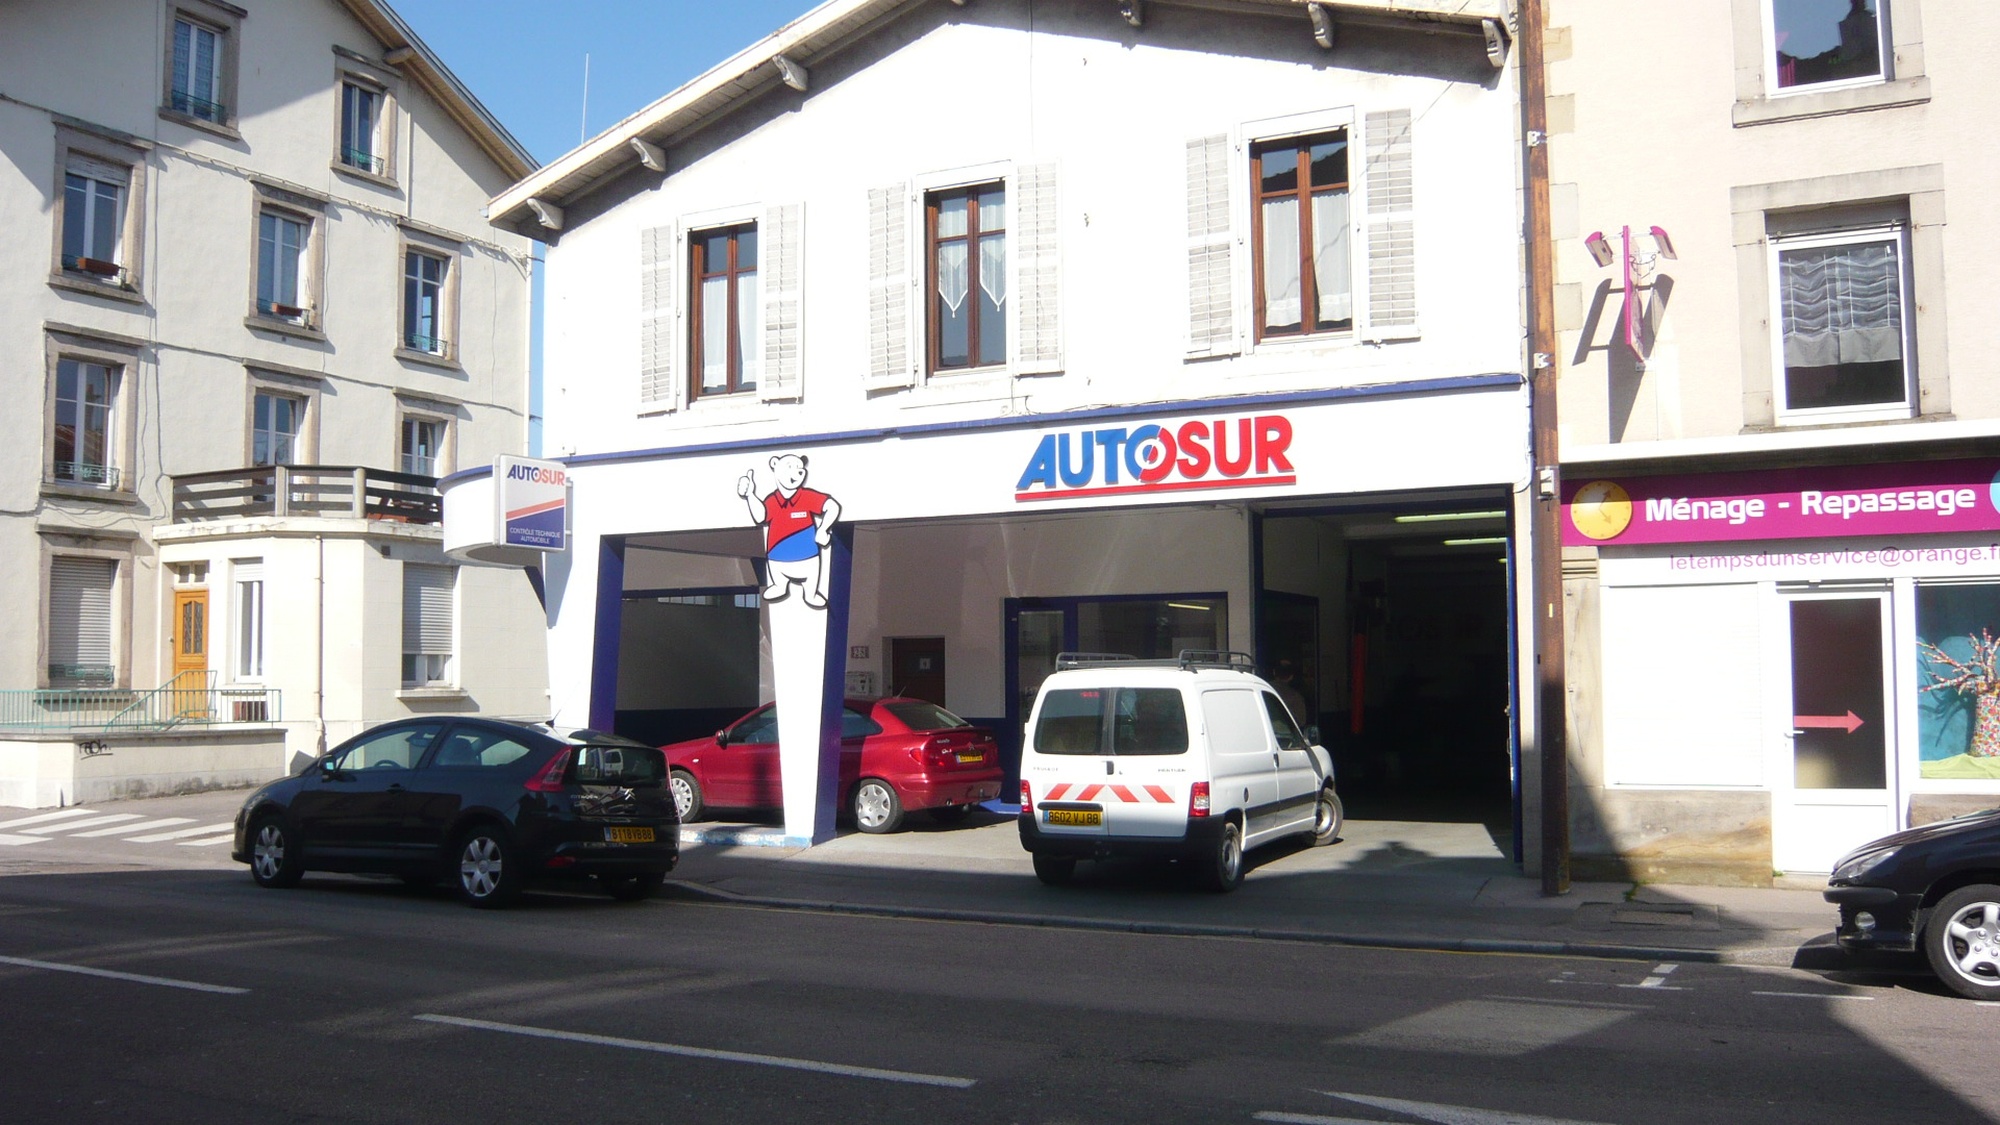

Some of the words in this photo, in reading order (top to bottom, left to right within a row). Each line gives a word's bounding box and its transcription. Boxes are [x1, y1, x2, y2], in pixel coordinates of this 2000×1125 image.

[1016, 415, 1295, 490] AUTOSUR
[507, 464, 565, 486] AUTOSUR
[1645, 497, 1765, 524] Ménage
[1801, 489, 1976, 519] Repassage
[520, 536, 550, 544] AUTOMOBILE
[535, 529, 561, 538] TECHNIQUE
[1670, 543, 2000, 571] letempsdunservice@orange.f
[1048, 811, 1071, 823] 8602
[1073, 812, 1085, 824] VJ
[1087, 813, 1099, 824] 88
